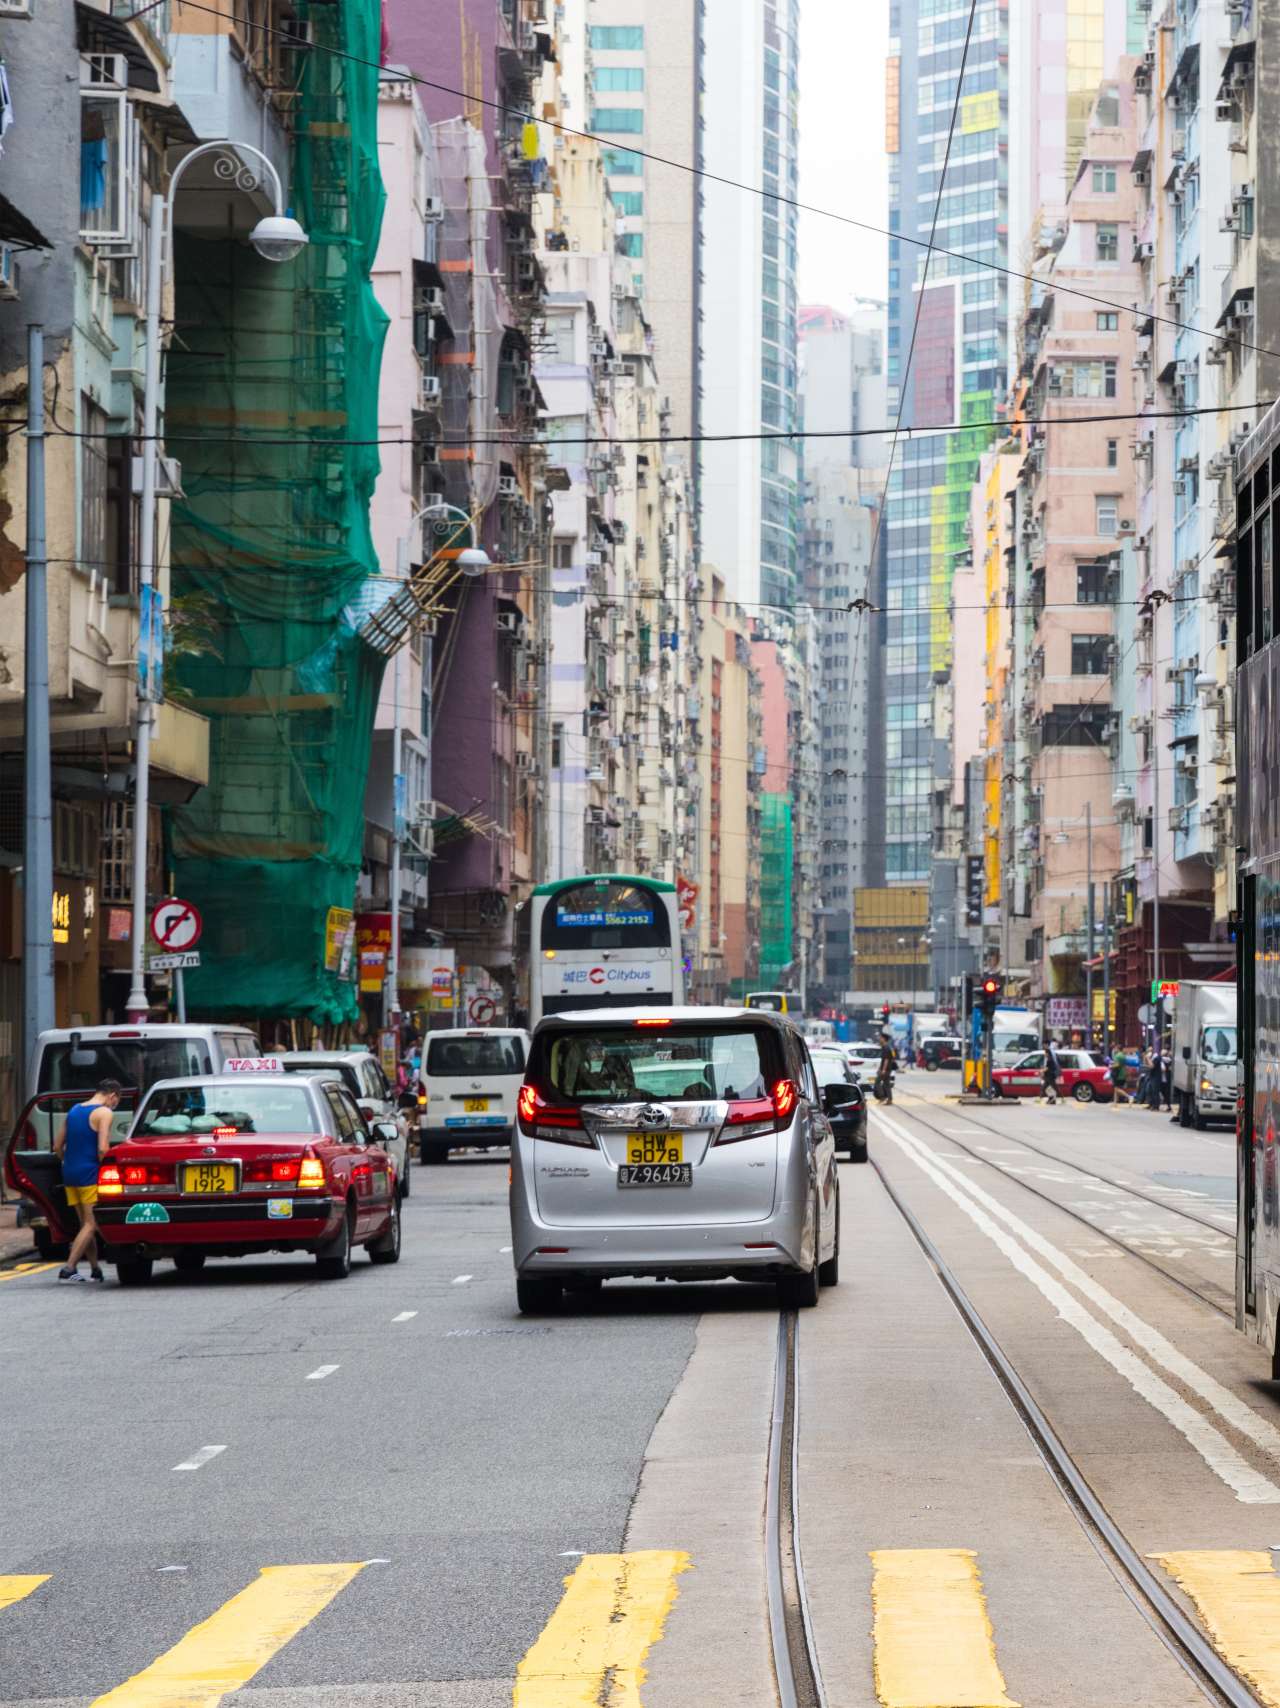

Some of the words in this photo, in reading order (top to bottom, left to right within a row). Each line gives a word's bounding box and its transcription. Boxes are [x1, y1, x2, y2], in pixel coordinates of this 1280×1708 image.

[177, 954, 199, 966] 7m
[607, 969, 650, 982] Citybus
[227, 1058, 278, 1071] TAXI
[643, 1134, 668, 1150] HW
[631, 1149, 680, 1164] 9078
[200, 1165, 221, 1180] HU
[193, 1179, 226, 1193] 1912
[143, 1207, 152, 1217] 4
